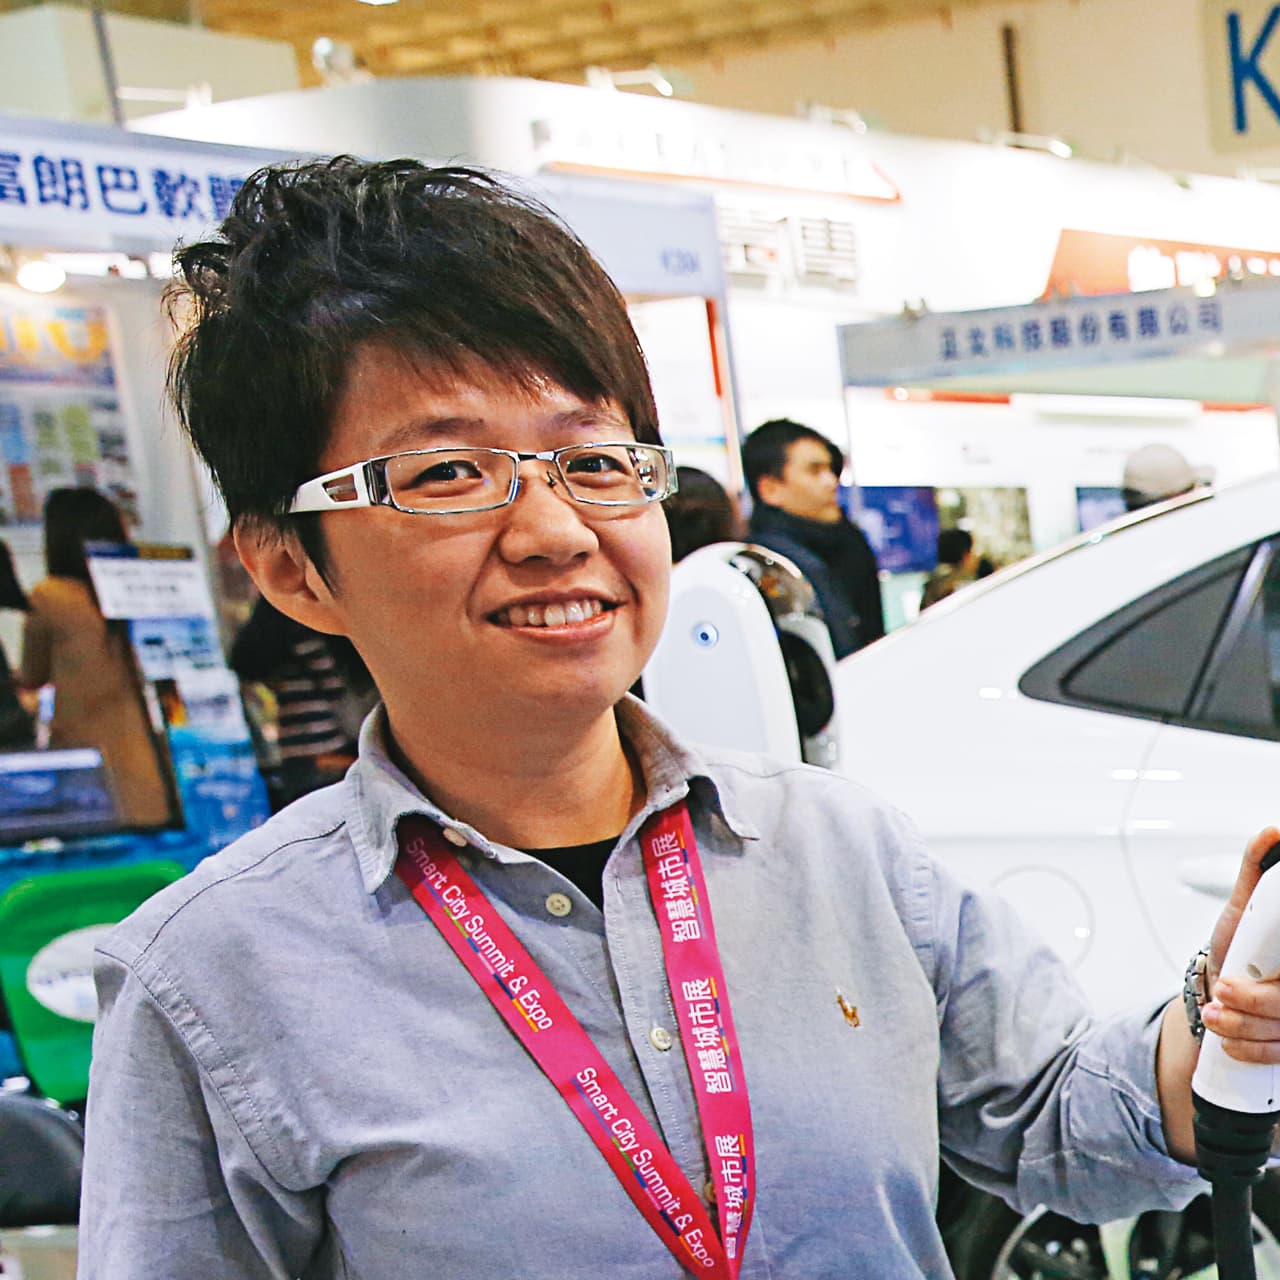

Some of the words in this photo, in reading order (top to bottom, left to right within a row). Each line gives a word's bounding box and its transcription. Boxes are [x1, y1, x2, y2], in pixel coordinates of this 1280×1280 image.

[406, 836, 448, 890] Smart
[652, 830, 702, 943] 智慧城市展
[442, 884, 471, 920] City
[464, 914, 515, 978] Summit
[509, 974, 530, 994] &
[519, 988, 553, 1030] Expo
[682, 977, 733, 1095] 智慧城市展
[576, 1066, 619, 1121] Smart
[610, 1117, 640, 1153] City
[632, 1148, 683, 1216] Summit
[674, 1212, 693, 1231] &
[685, 1228, 715, 1269] Expo
